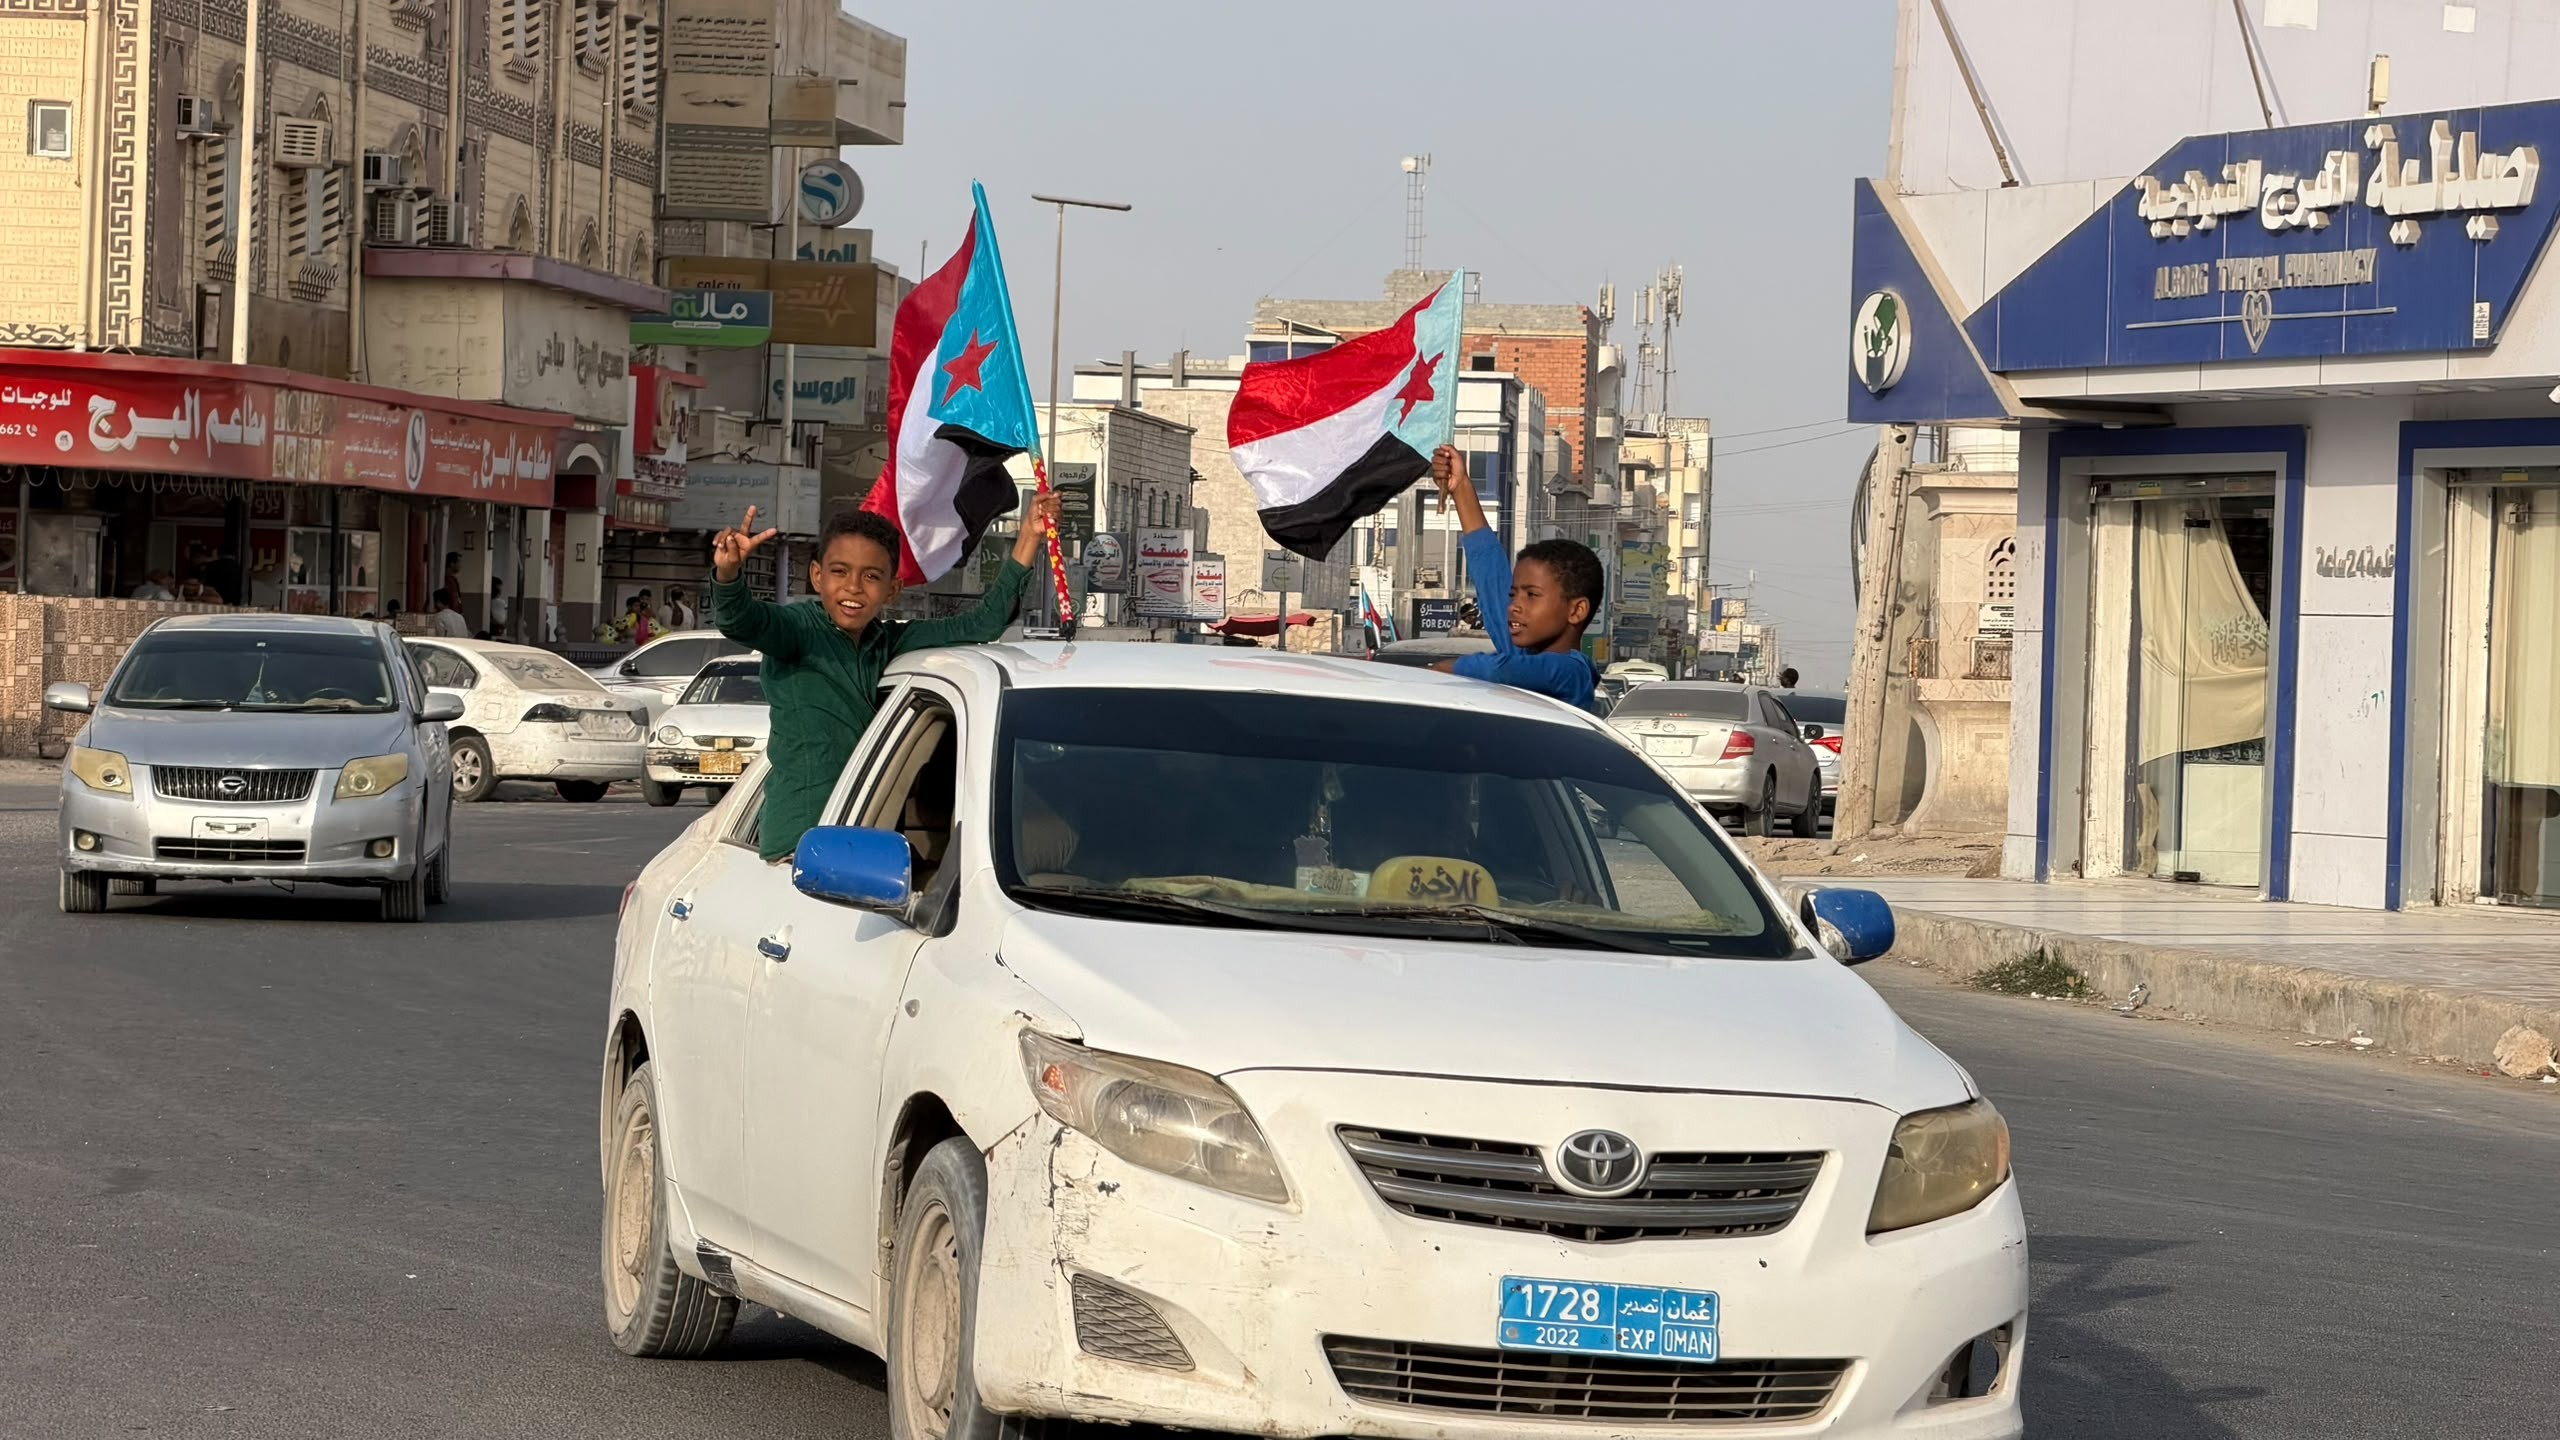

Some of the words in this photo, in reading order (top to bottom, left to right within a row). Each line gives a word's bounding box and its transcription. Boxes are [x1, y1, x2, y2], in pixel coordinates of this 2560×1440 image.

[2261, 150, 2360, 231] البرج
[2364, 119, 2541, 246] صيدلية
[2154, 263, 2209, 300] ALBORG
[2216, 255, 2284, 292] TYPICAL
[2284, 248, 2378, 288] PHARMACY
[88, 387, 200, 455] البرج
[206, 393, 267, 458] مطاعم
[481, 431, 516, 489] البرج
[514, 434, 551, 490] مطاعم
[1140, 543, 1189, 559] مسقط
[1421, 618, 1437, 629] FOR
[1519, 1283, 1602, 1323] 1728
[1619, 1296, 1660, 1317] تصدير
[1535, 1326, 1580, 1347] 2022
[1619, 1327, 1656, 1351] EXP
[1664, 1328, 1713, 1356] OMAN
